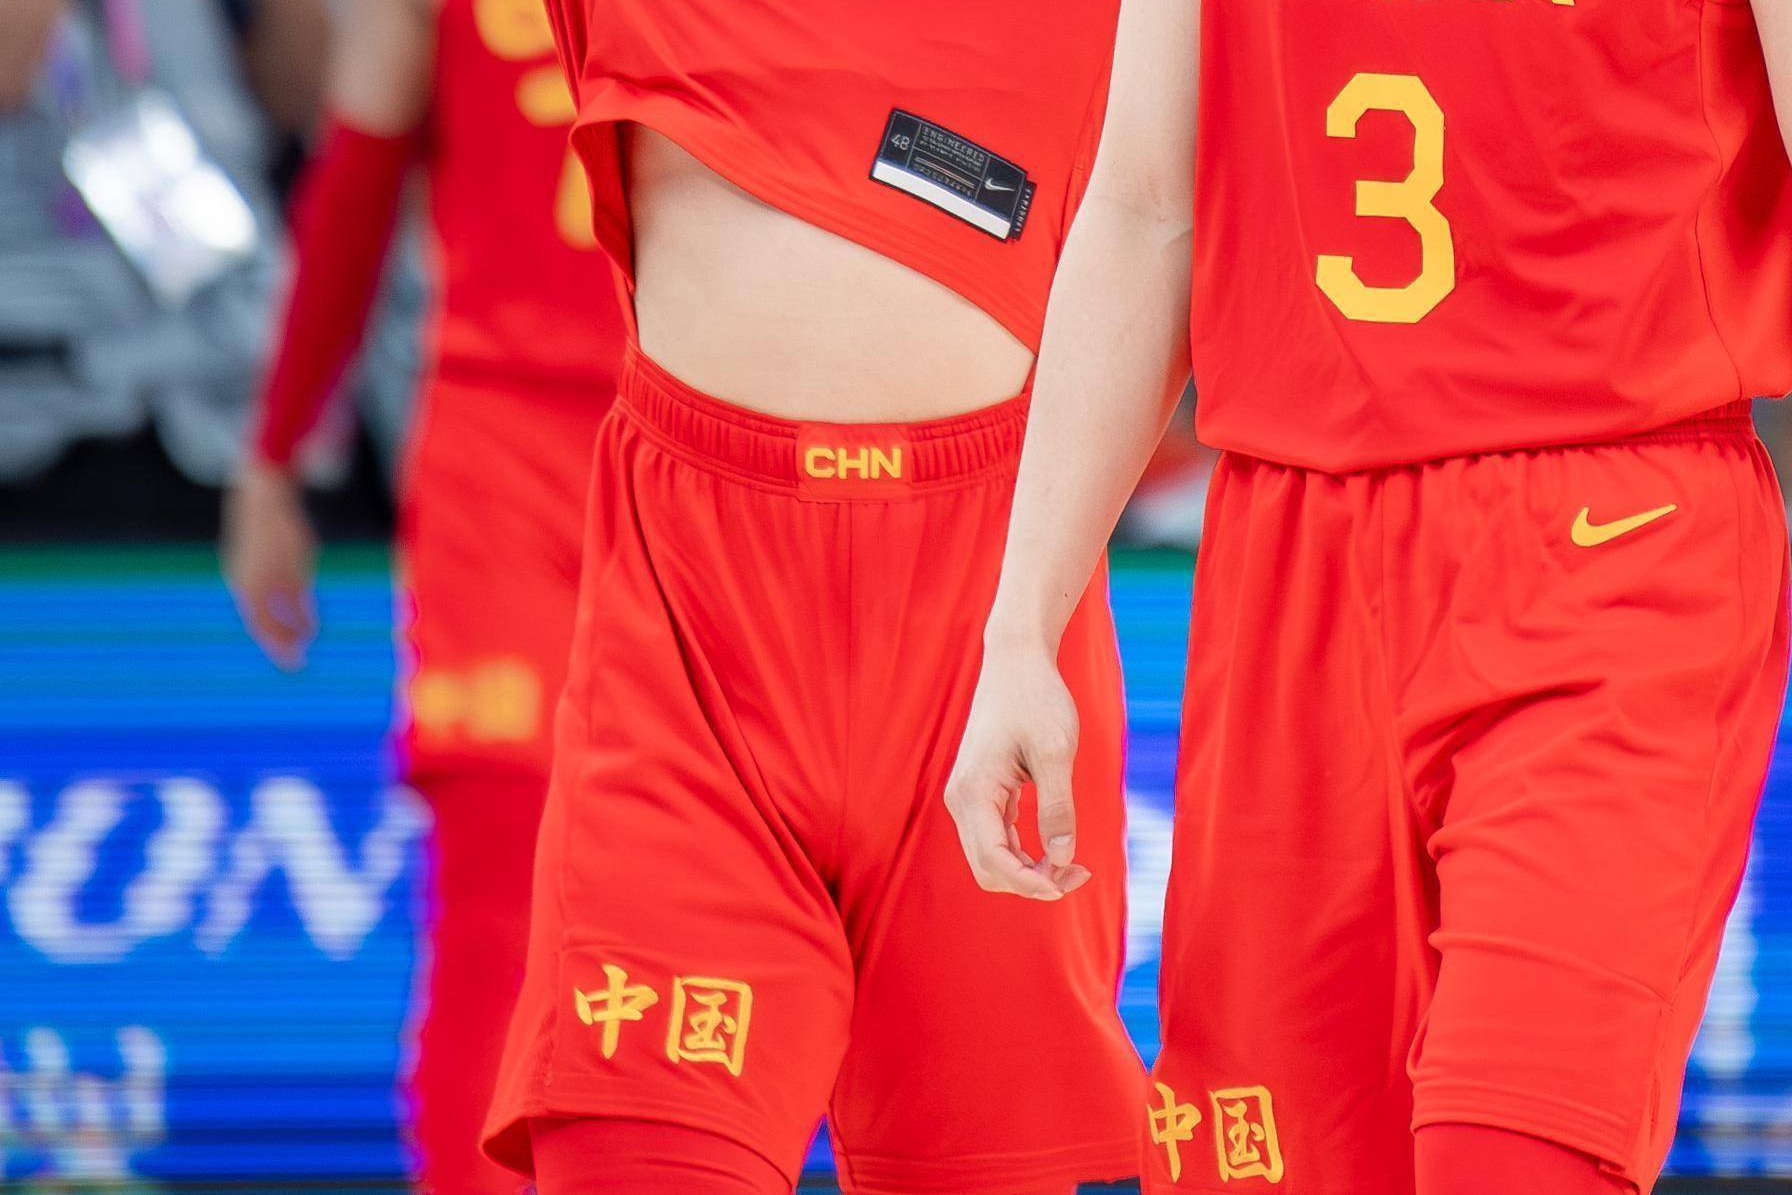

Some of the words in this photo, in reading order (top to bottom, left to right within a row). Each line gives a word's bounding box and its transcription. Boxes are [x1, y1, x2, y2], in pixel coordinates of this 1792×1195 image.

[891, 133, 911, 151] 48
[1315, 72, 1456, 324] 3
[804, 446, 902, 480] CHN
[574, 963, 754, 1077] 中国
[1146, 1081, 1285, 1185] 中国
